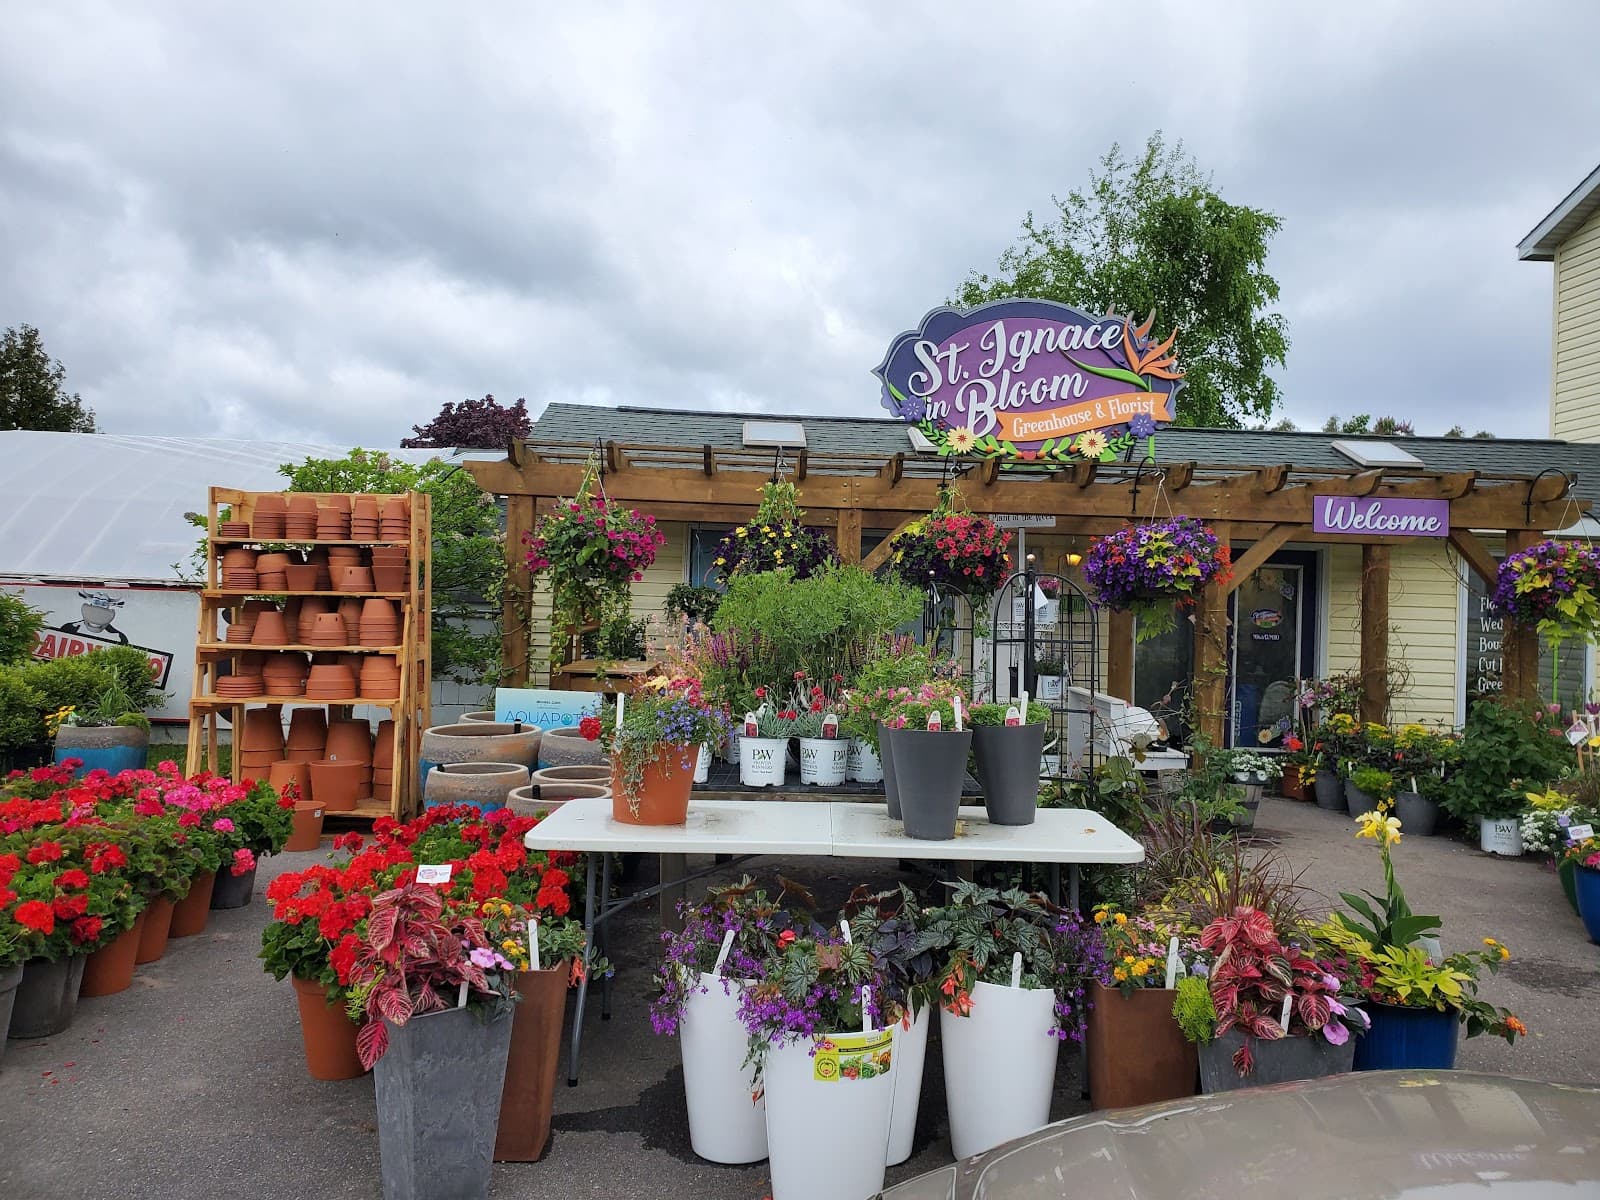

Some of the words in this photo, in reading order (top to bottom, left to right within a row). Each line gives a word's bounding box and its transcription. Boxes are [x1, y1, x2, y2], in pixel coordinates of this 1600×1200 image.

[908, 339, 969, 397] St.
[981, 320, 1125, 372] Ignace
[926, 396, 950, 421] in
[955, 371, 1089, 438] Bloom
[1013, 411, 1093, 438] Greenhouse
[1095, 402, 1107, 418] &
[1108, 396, 1156, 420] Florist
[1324, 498, 1441, 532] Welcome
[1480, 596, 1498, 612] Flo
[1479, 656, 1496, 672] Cut
